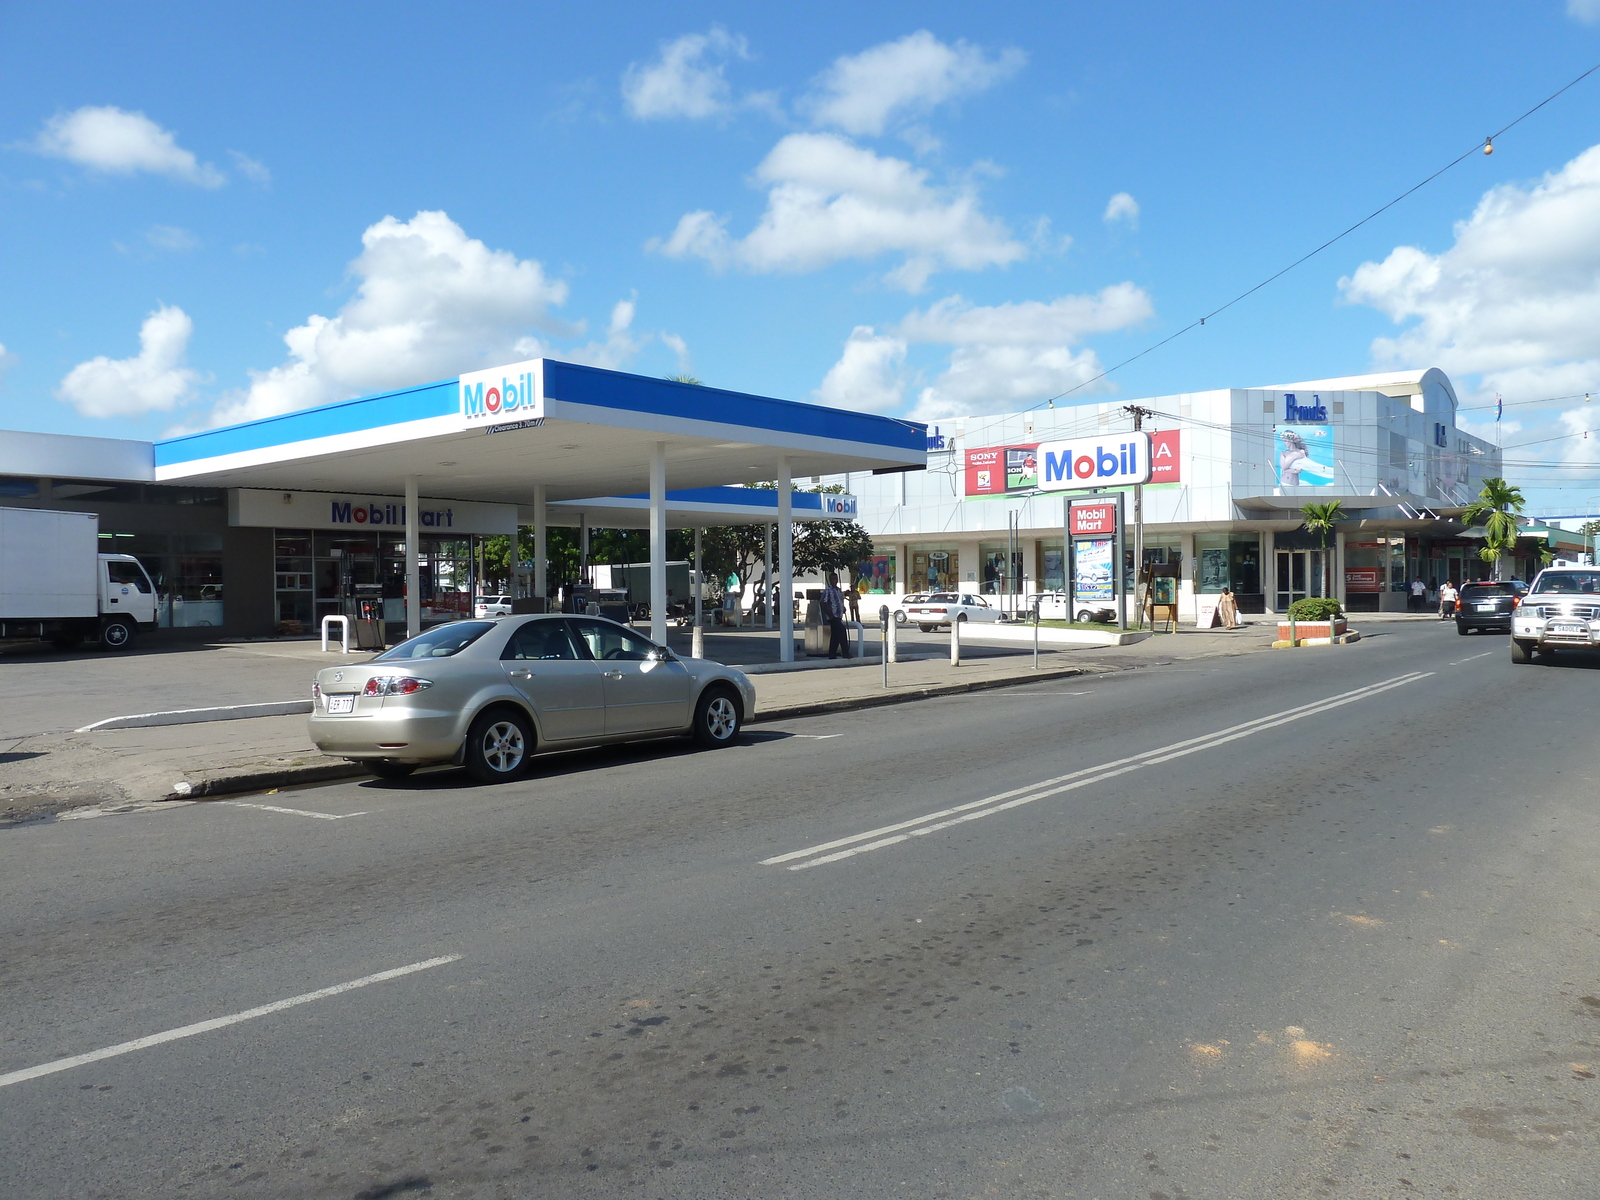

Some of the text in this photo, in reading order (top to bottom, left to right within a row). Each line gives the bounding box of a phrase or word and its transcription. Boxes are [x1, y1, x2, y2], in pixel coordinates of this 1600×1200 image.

[464, 372, 534, 417] Mobil
[494, 423, 519, 432] Clearance
[970, 452, 998, 461] SONY
[1045, 442, 1136, 482] Mobil
[827, 498, 856, 513] Mobil
[331, 502, 453, 527] Mobil art
[1077, 508, 1106, 520] Mobil
[1077, 520, 1102, 531] Mart
[342, 699, 352, 710] 777
